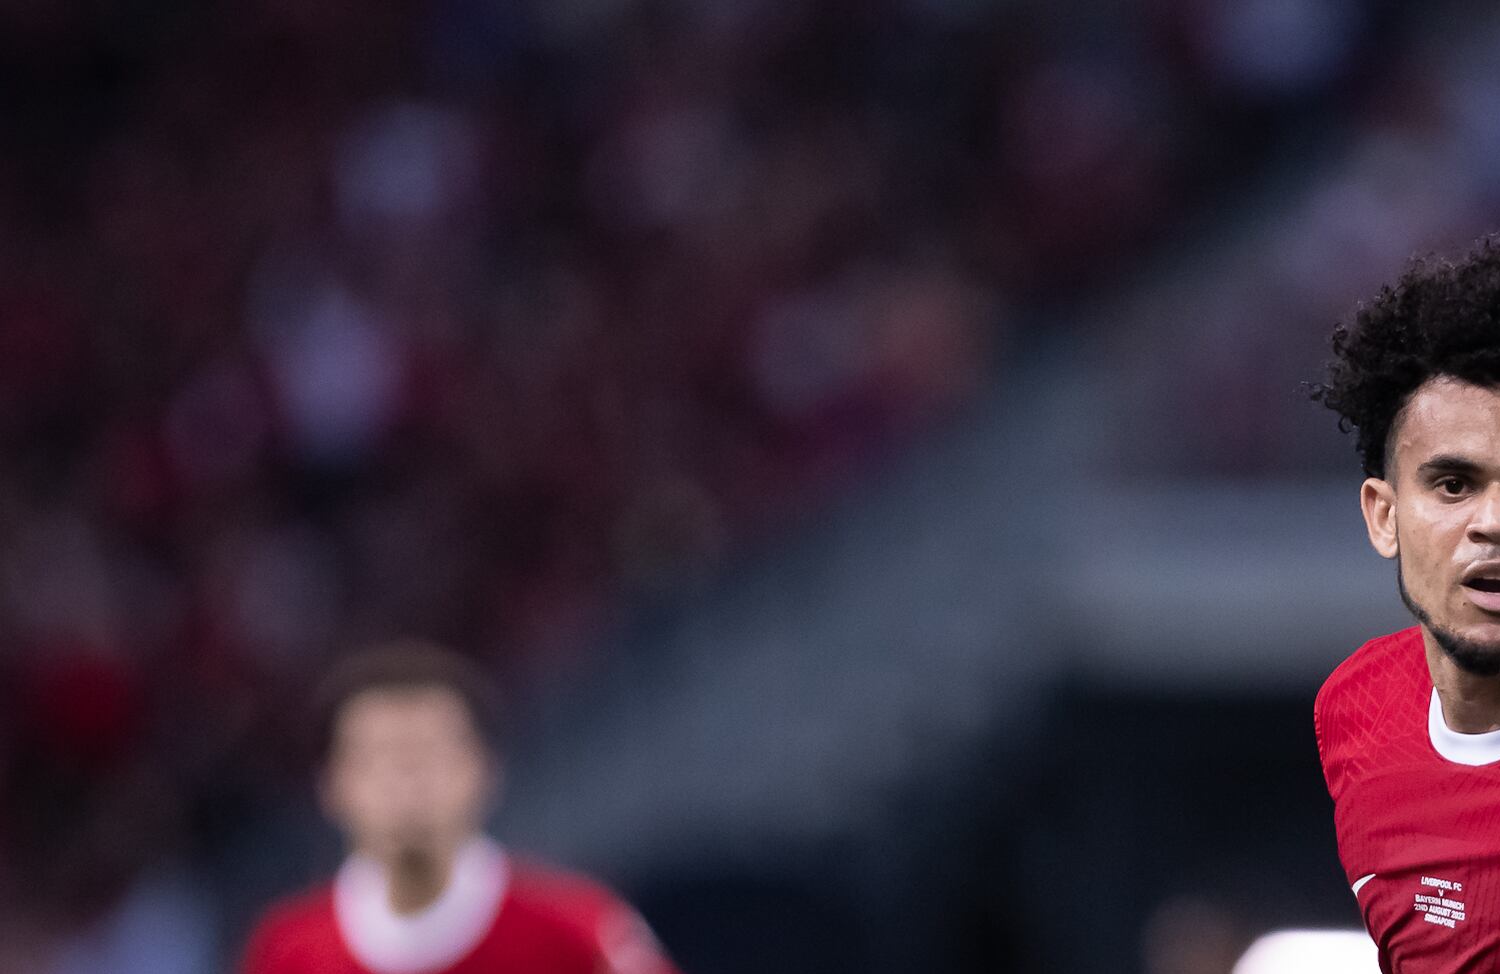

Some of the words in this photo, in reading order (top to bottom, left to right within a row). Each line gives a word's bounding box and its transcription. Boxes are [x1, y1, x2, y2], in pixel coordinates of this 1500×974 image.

[1421, 876, 1452, 889] LIVERPOOL
[1453, 882, 1462, 891] FC
[1415, 894, 1441, 905] BAYERN
[1441, 898, 1464, 910] MUNICH
[1424, 913, 1455, 928] SINGAPORE
[1428, 905, 1451, 917] AUGUST
[1450, 910, 1465, 921] 2023
